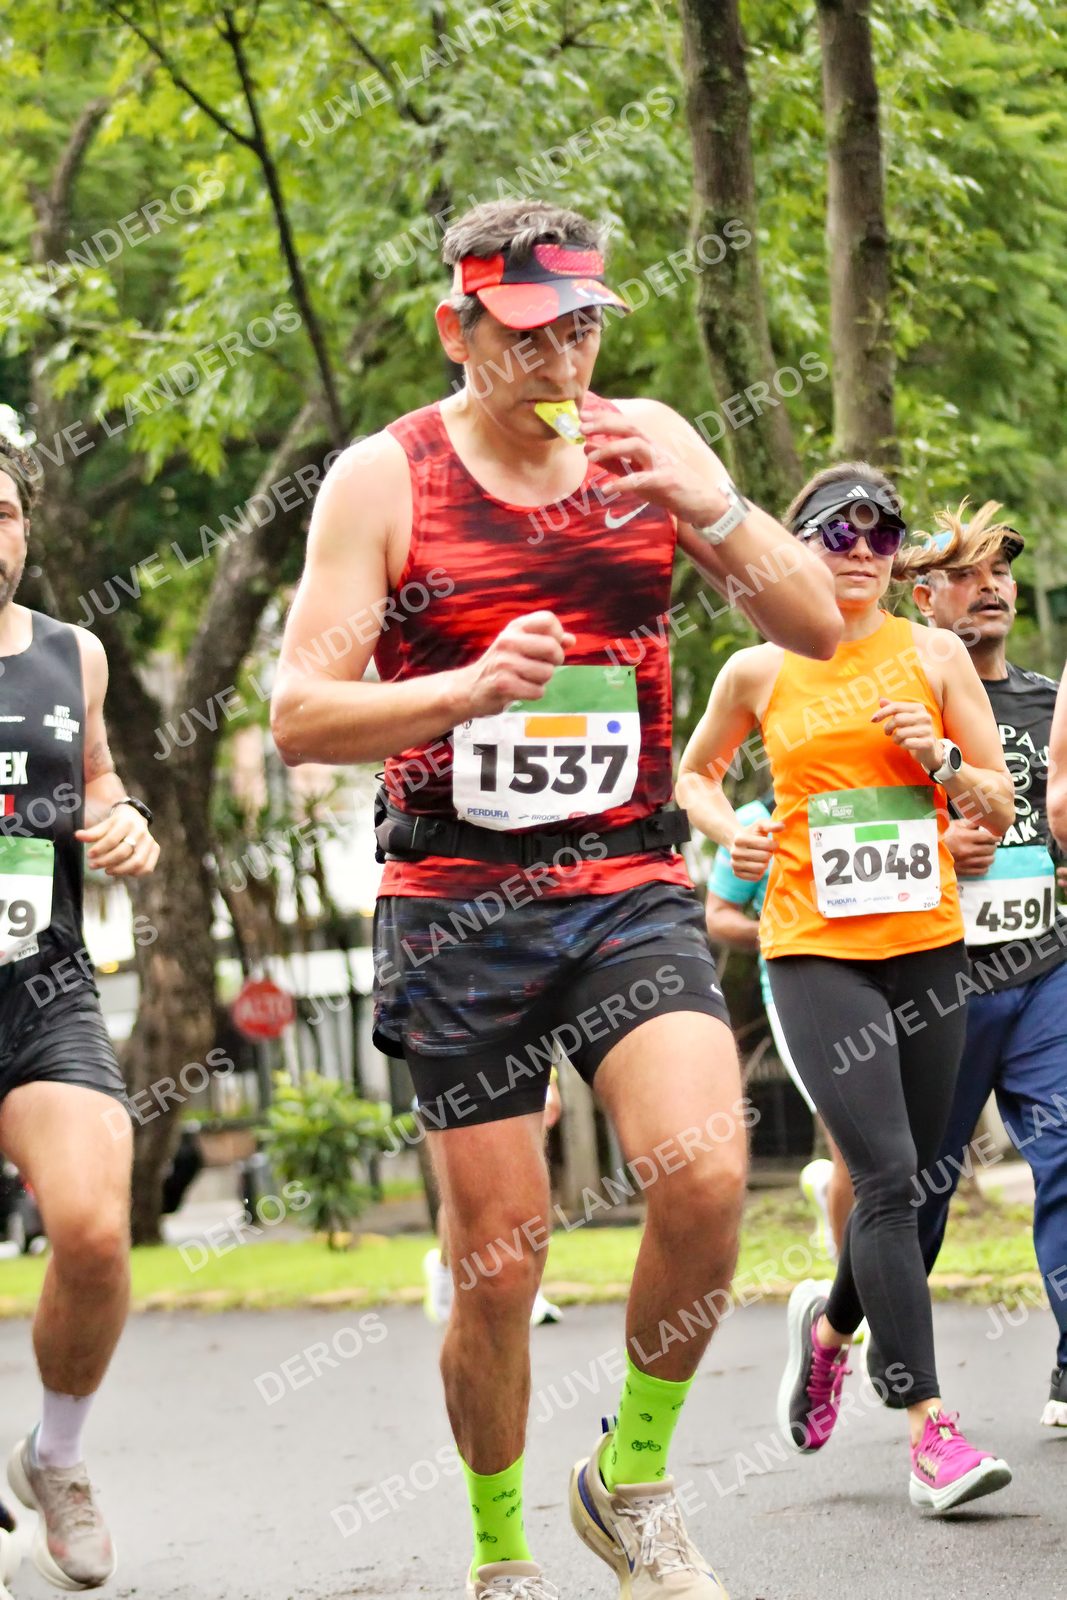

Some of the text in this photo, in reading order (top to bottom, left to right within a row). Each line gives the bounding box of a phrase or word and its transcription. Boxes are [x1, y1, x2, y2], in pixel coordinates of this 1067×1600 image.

[473, 743, 628, 795] 1537
[467, 807, 510, 819] PERDURA
[531, 813, 561, 822] BROOKS
[822, 843, 932, 886] 2048
